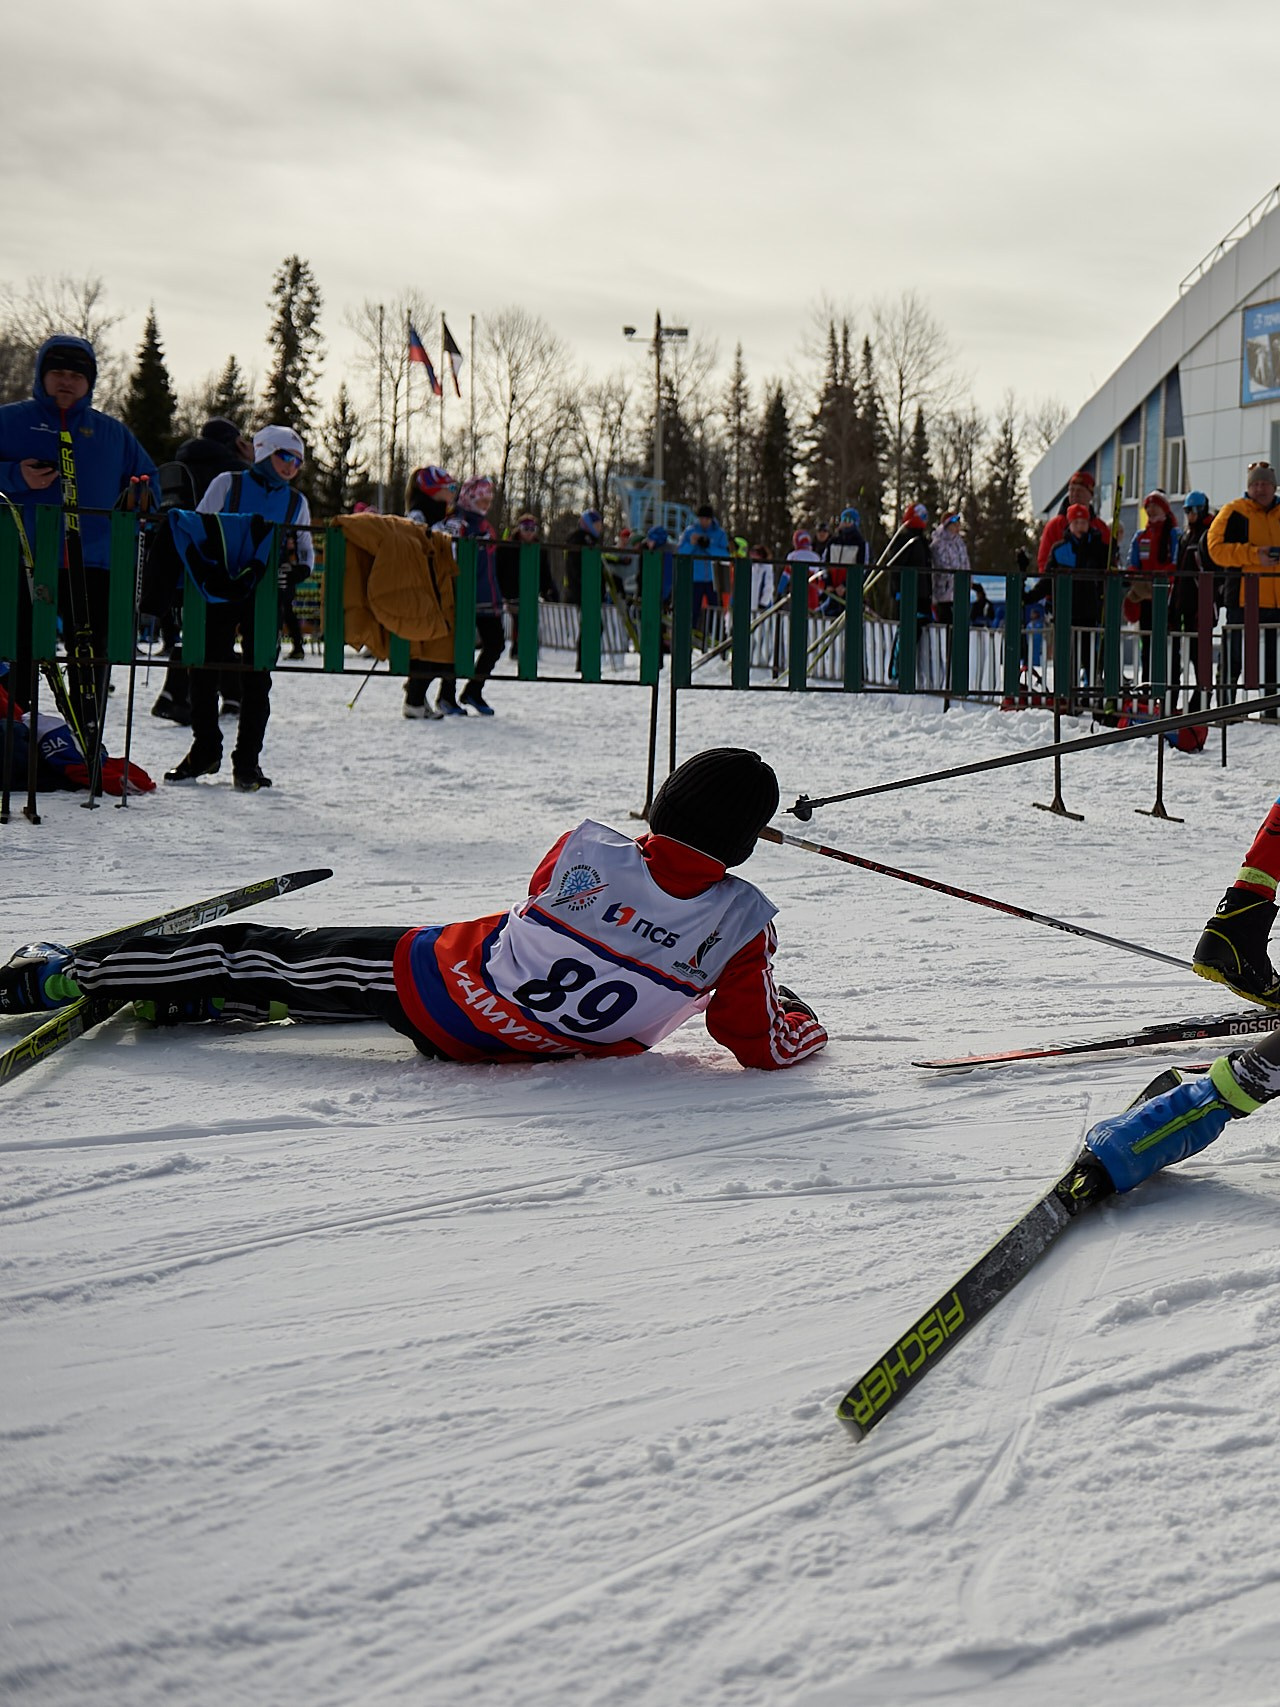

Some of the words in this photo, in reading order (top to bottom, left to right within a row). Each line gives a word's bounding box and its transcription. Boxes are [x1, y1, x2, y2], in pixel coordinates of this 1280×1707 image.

[243, 879, 276, 896] FISCHER
[632, 918, 681, 949] ПСБ
[449, 959, 584, 1055] УДМУРТИ
[512, 957, 638, 1034] 89
[846, 1291, 965, 1426] FISCHER
